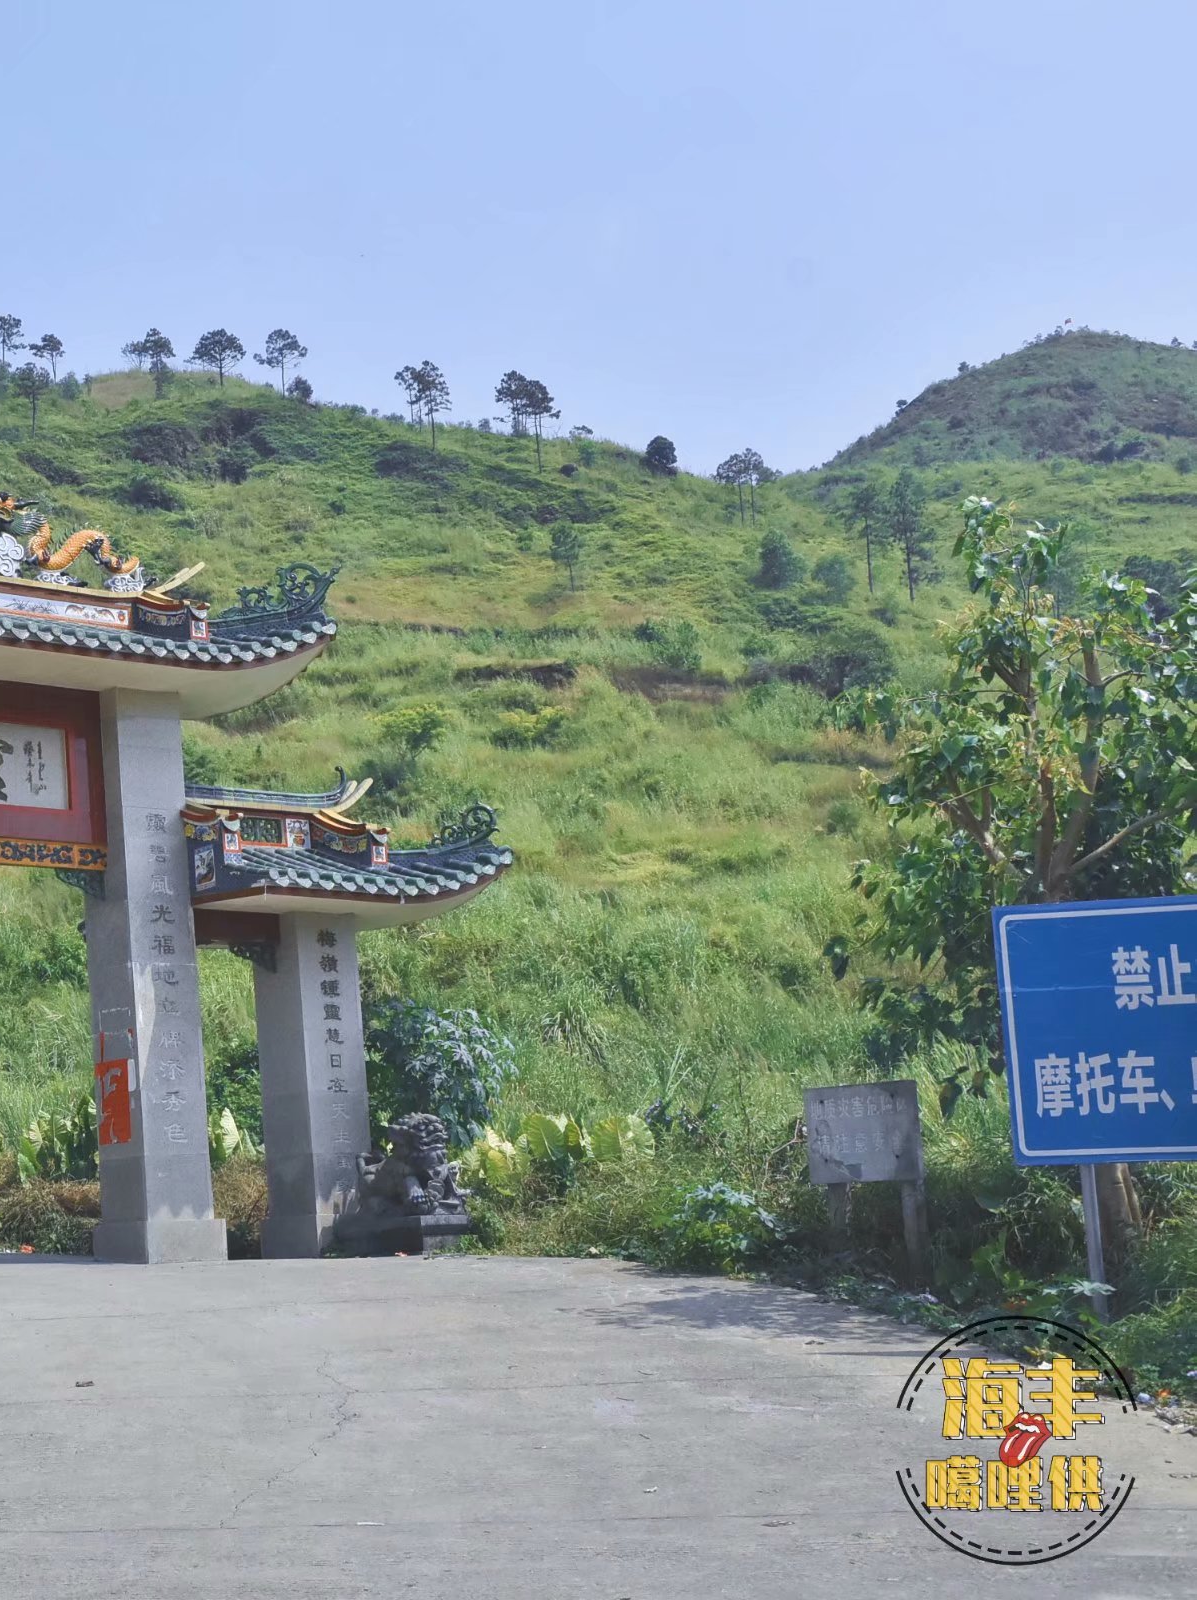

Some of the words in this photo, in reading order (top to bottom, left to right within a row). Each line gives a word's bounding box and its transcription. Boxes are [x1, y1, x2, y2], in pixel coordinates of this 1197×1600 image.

[1111, 943, 1197, 1010] 禁止
[810, 1096, 908, 1120] 地质灾害危险区
[1034, 1050, 1197, 1119] 摩托车、
